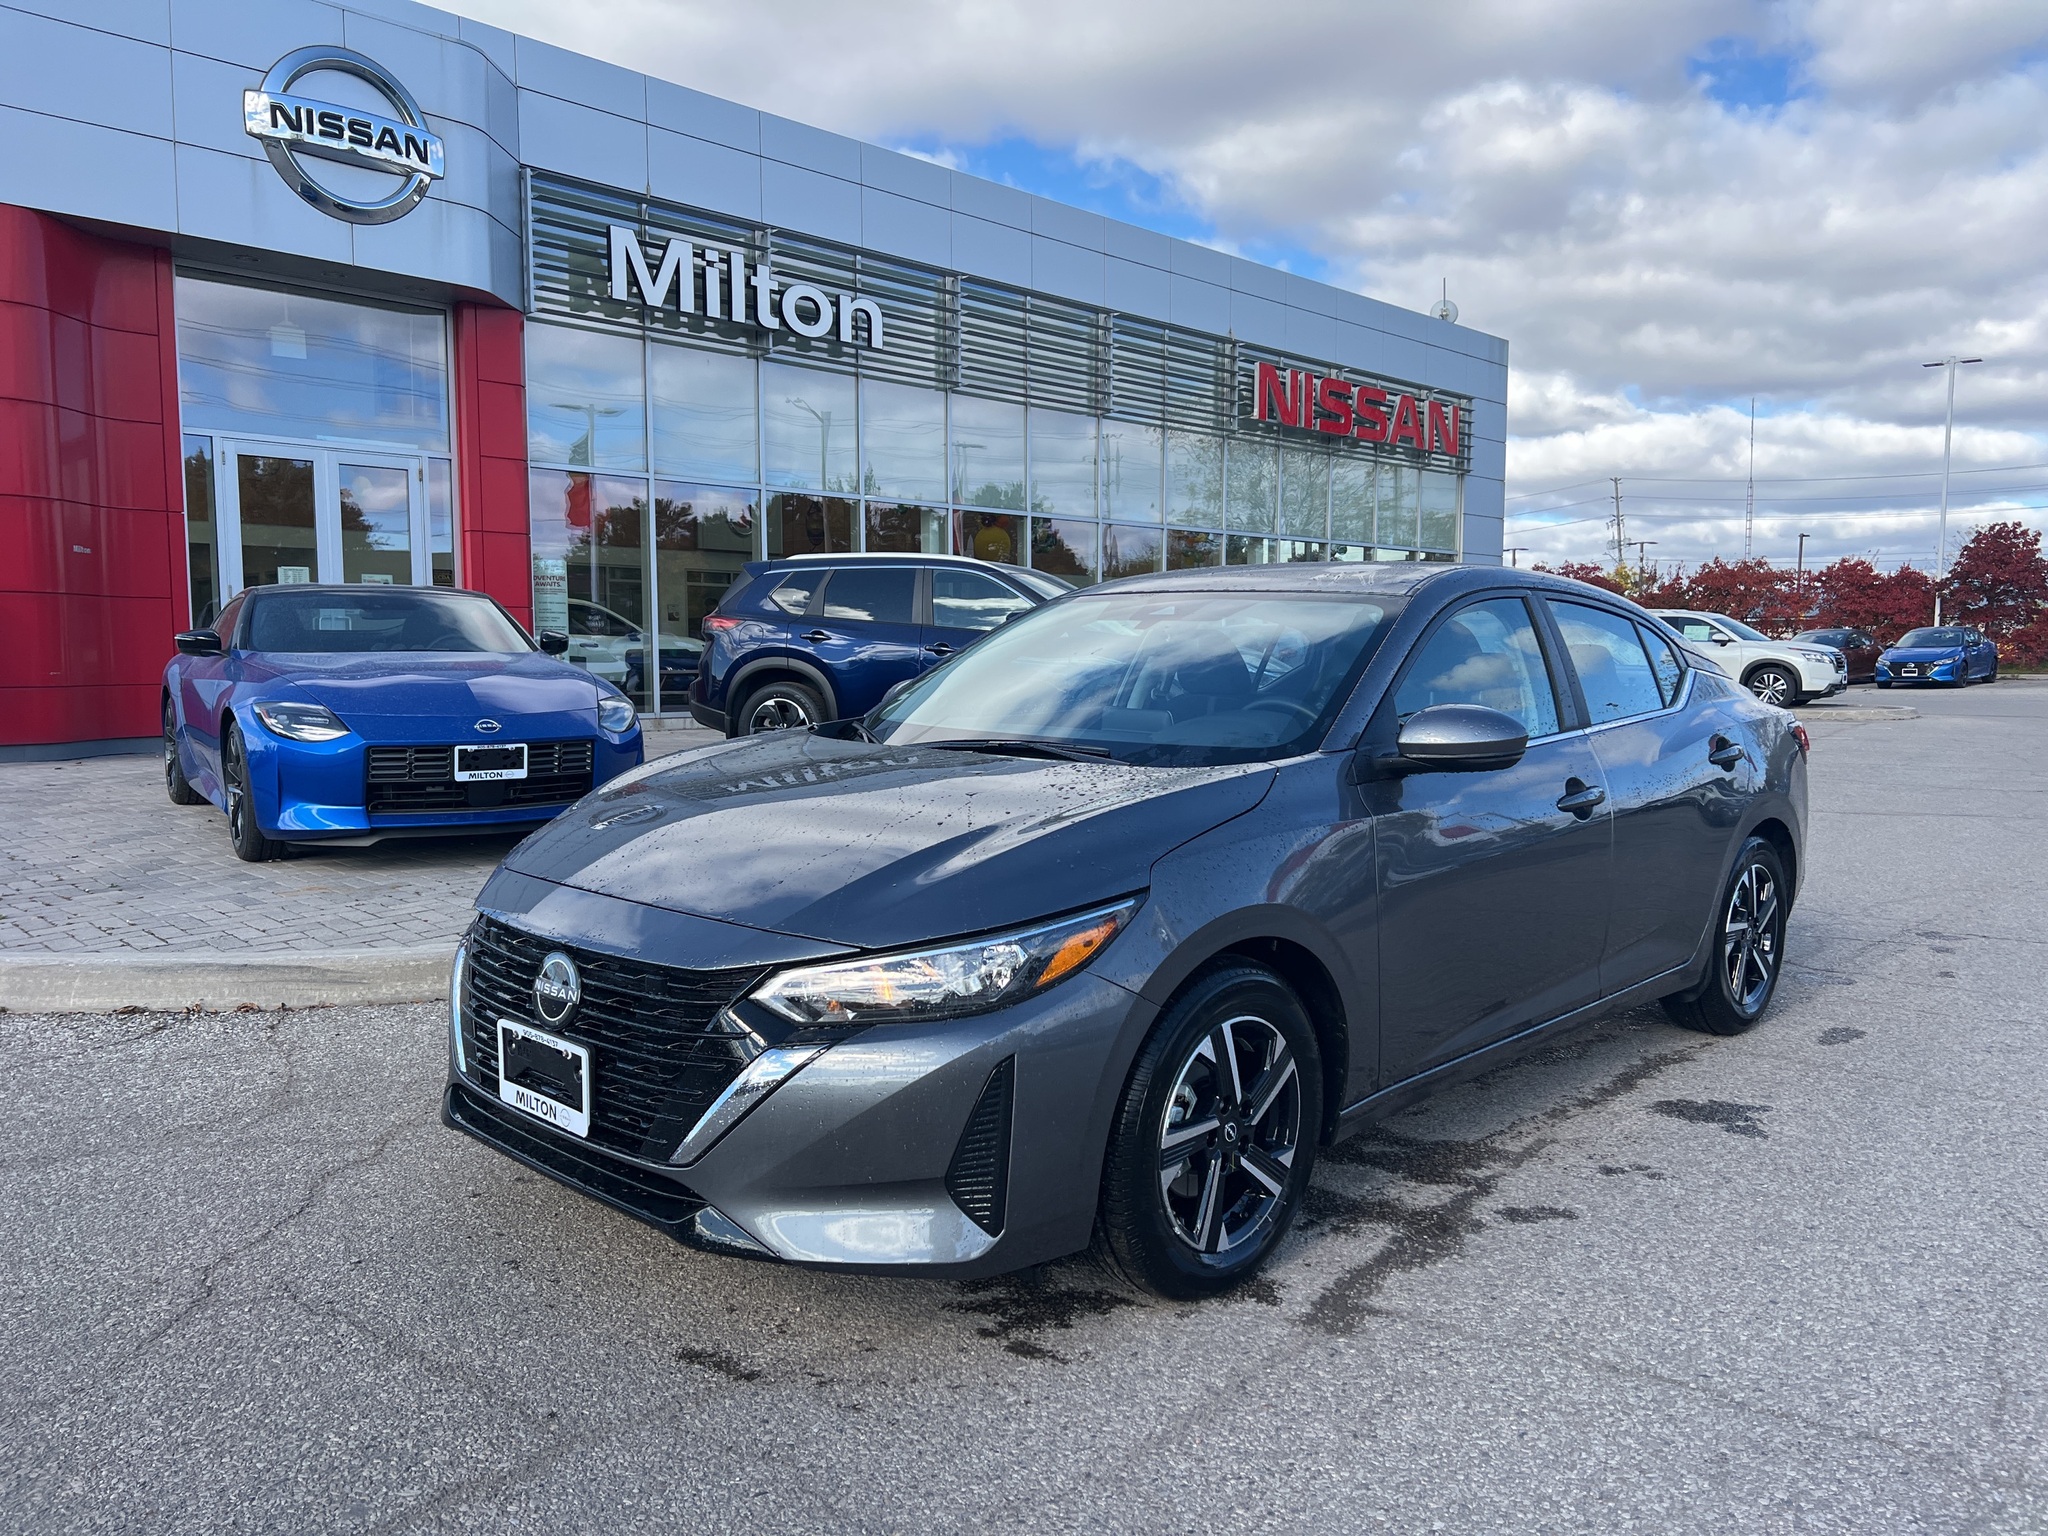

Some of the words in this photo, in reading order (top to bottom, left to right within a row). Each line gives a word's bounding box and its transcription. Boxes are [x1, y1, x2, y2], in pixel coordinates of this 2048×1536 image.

[269, 101, 430, 165] NISSAN
[606, 224, 883, 349] Milton
[1253, 361, 1460, 456] NISSAN
[468, 771, 503, 780] MILTON
[535, 978, 577, 1002] NISSAN
[516, 1089, 557, 1121] MILTON
